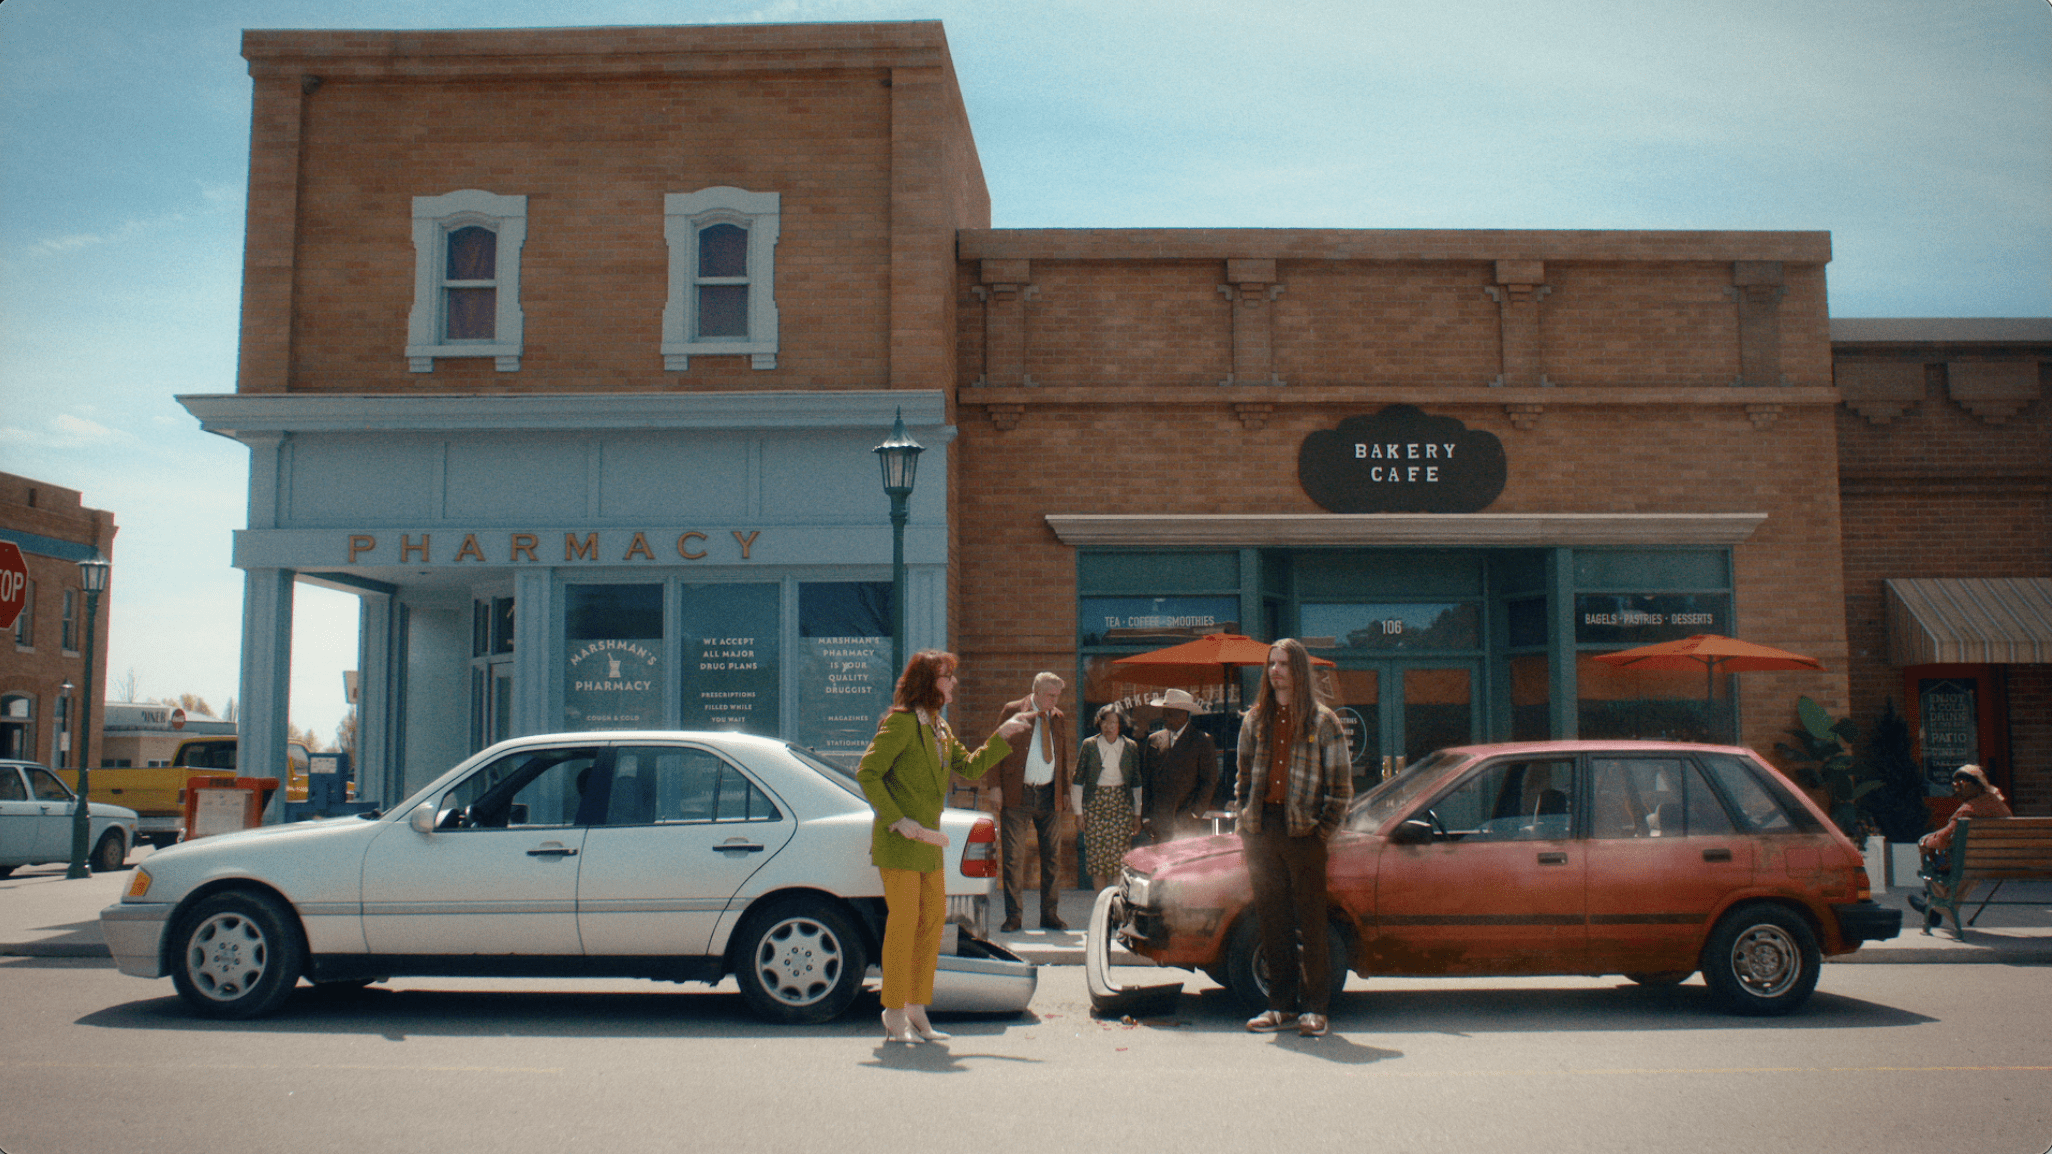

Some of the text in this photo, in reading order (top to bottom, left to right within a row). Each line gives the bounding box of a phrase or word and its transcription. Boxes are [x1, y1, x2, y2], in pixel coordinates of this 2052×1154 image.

[1355, 443, 1456, 459] BAKERY
[1370, 466, 1439, 482] CAFE
[348, 531, 761, 563] PHARMACY
[0, 569, 24, 602] OP
[1104, 615, 1215, 628] TEA COFFEE SMOOTHIES
[1585, 613, 1714, 625] BAGELS PASTRIES DESSERTS
[1382, 620, 1403, 635] 106
[703, 638, 755, 646] WE ACCEPT
[818, 636, 880, 644] MARSHMAN'S
[570, 639, 657, 666] MARSHMAN'S
[703, 650, 755, 658] ALL MAJOR
[823, 649, 875, 657] PHARMACY
[700, 662, 758, 671] DRUG PLANS
[828, 674, 869, 682] QUALITY
[575, 680, 652, 691] PHARMACY
[825, 686, 873, 694] DRUGGIST
[701, 691, 756, 699] PRESCRIPTIONS
[1931, 732, 1968, 743] PATIO
